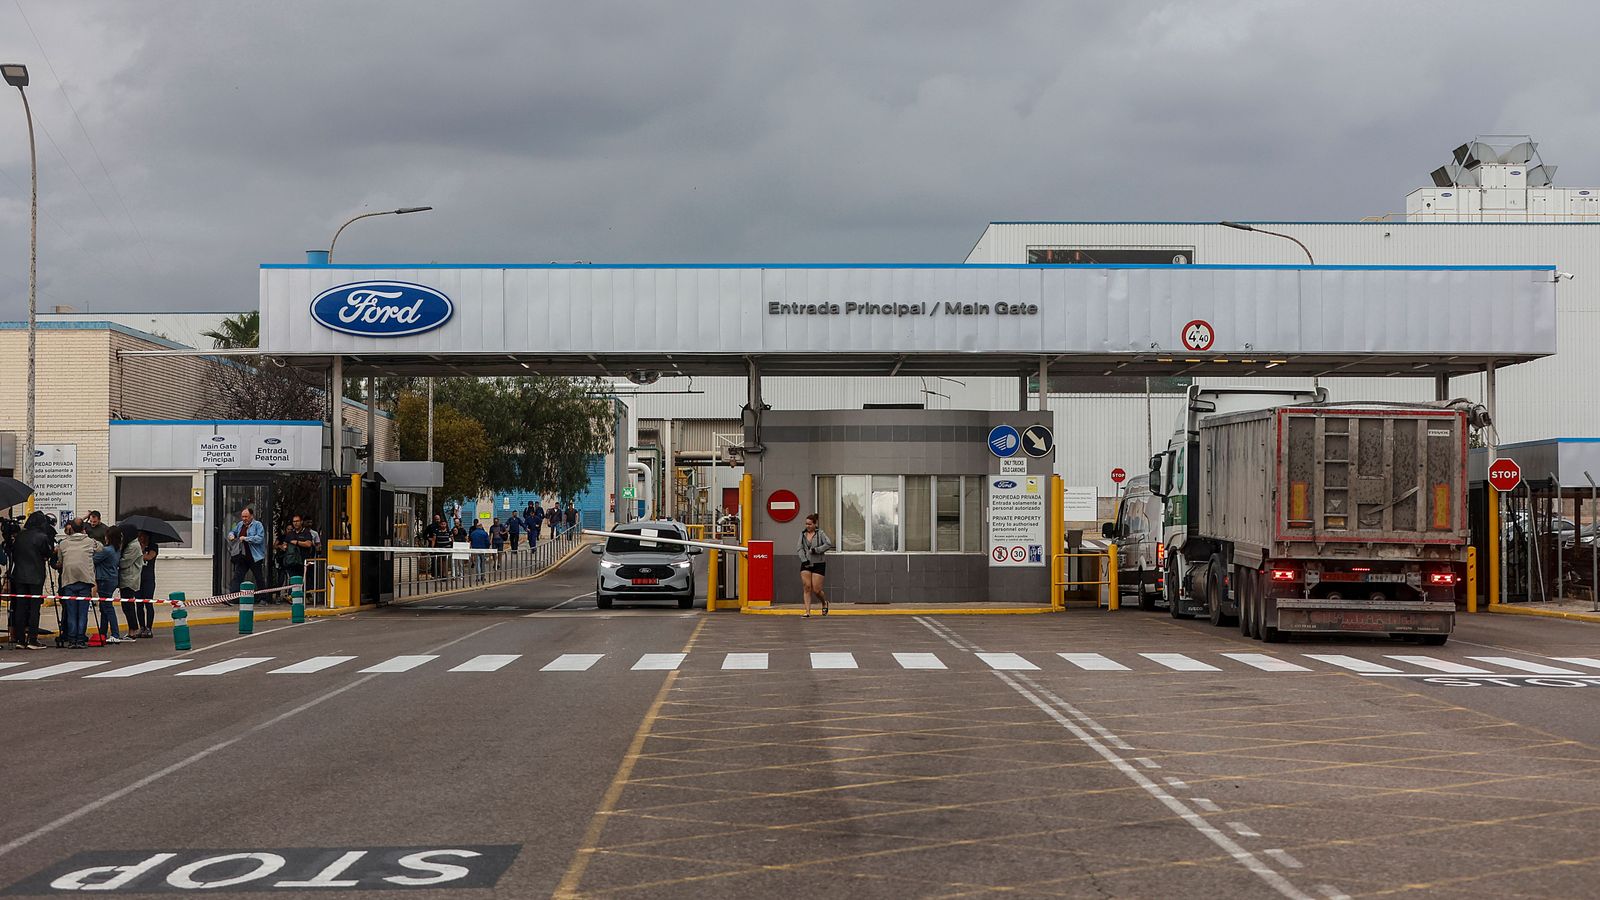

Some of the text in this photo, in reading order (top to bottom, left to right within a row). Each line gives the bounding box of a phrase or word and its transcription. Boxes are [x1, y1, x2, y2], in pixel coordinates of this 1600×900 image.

[338, 289, 424, 324] Ford
[768, 301, 840, 316] Entrada
[845, 301, 926, 318] Principal
[944, 301, 990, 316] Main
[994, 301, 1039, 316] Gate
[1491, 470, 1518, 479] STOP
[1013, 550, 1023, 558] 30
[49, 849, 483, 891] STOP
